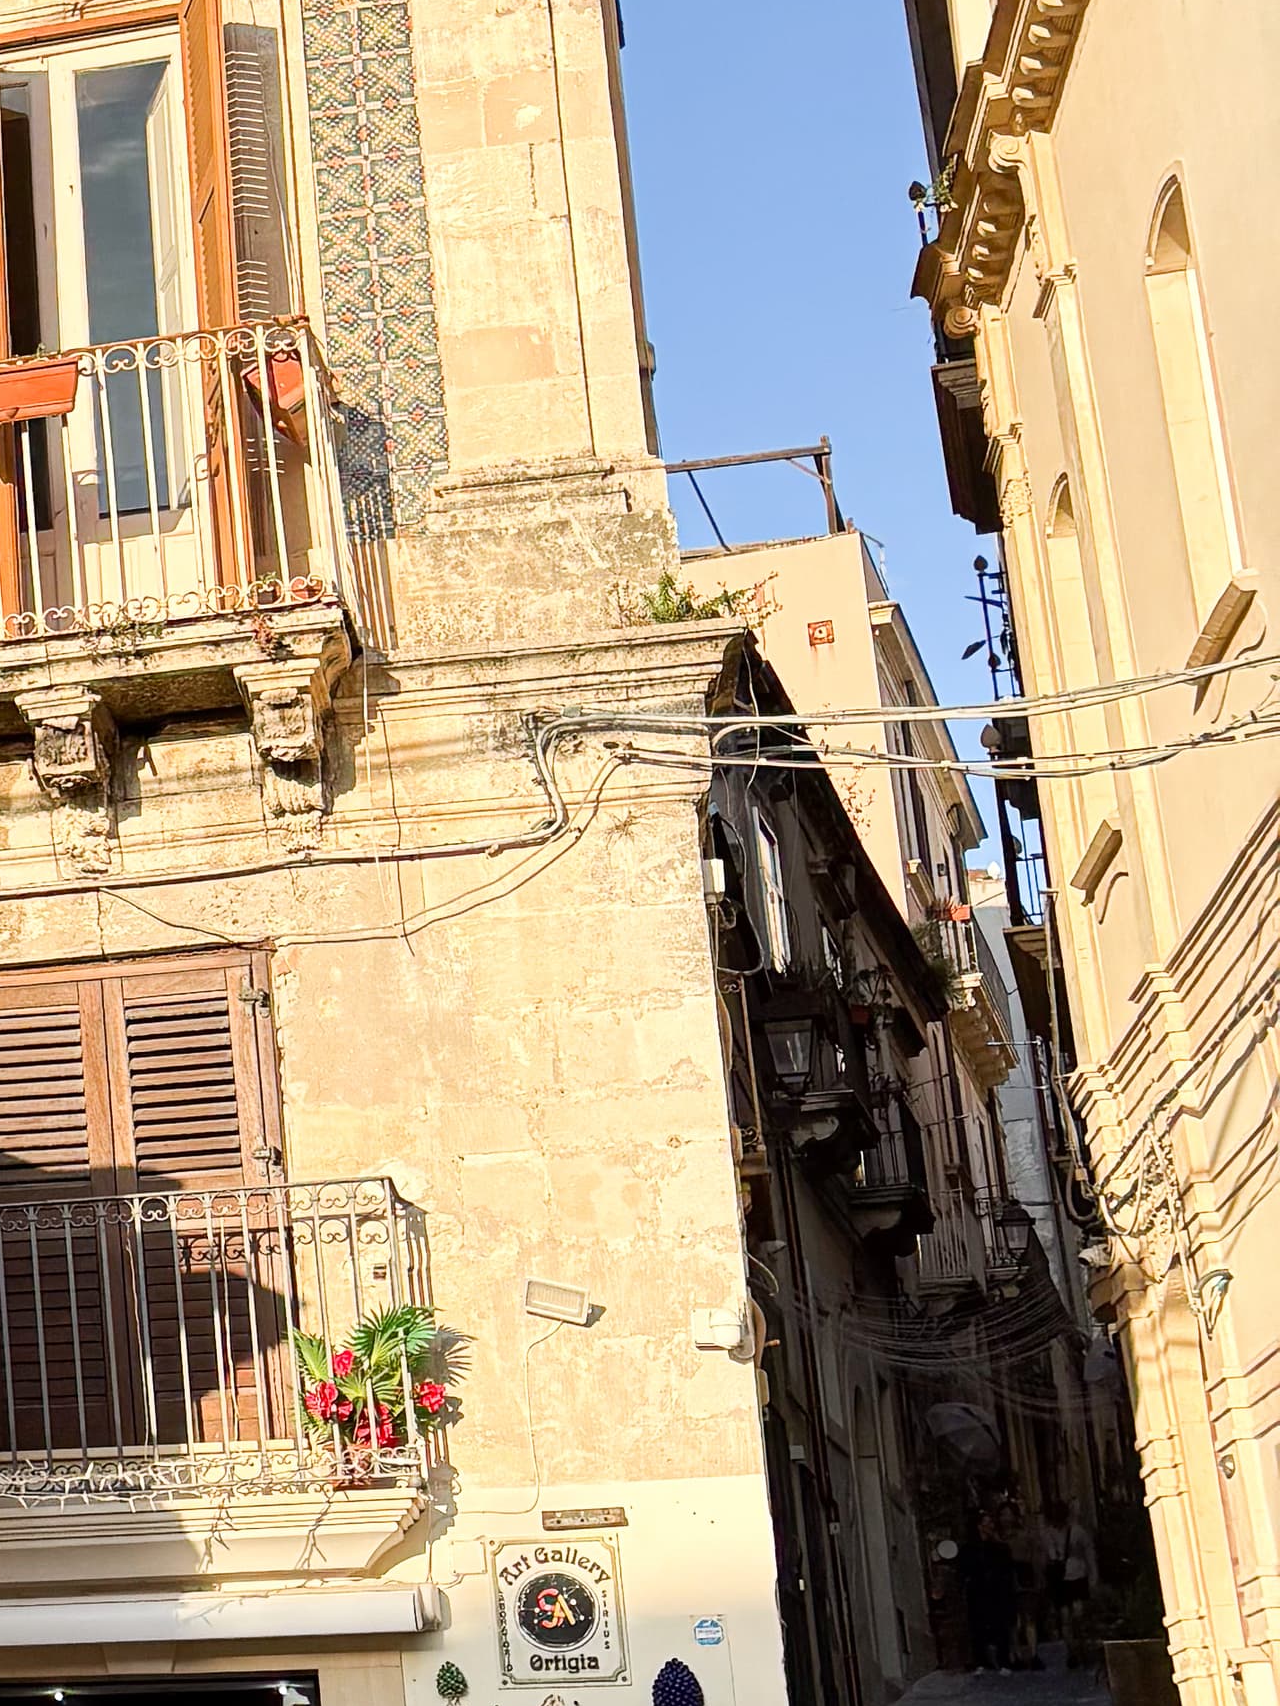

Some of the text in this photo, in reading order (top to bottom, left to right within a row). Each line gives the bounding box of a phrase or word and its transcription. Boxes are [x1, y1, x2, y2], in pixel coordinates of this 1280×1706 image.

[499, 1547, 612, 1586] Art Gallery
[529, 1653, 600, 1674] Ortigia
